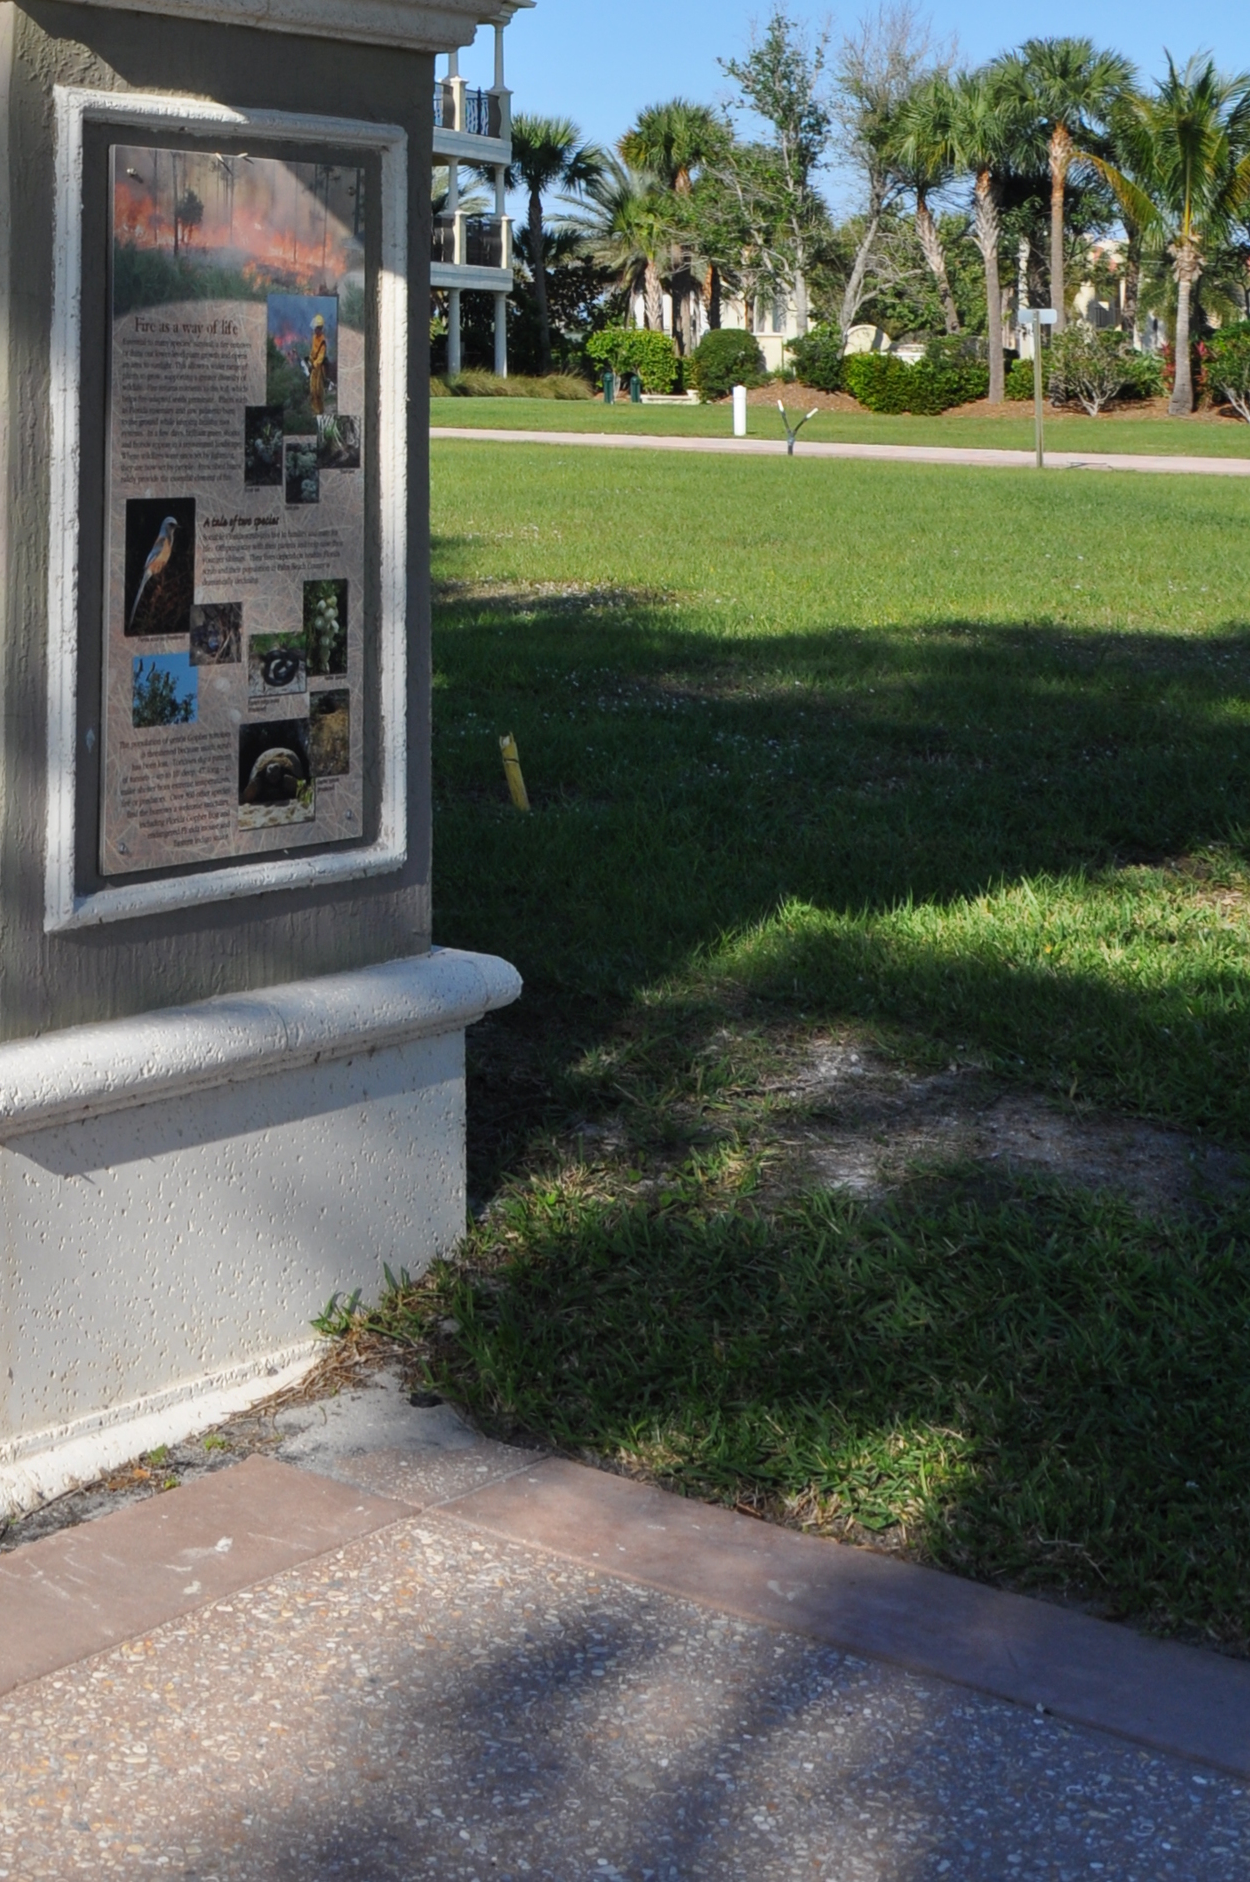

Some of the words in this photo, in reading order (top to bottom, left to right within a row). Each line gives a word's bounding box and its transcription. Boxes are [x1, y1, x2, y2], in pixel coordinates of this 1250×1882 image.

[135, 317, 156, 333] Fire
[159, 323, 170, 333] as
[173, 323, 179, 333] a
[182, 324, 204, 338] way
[207, 319, 217, 335] of
[221, 319, 239, 335] life
[203, 517, 211, 527] A
[211, 515, 228, 527] tale
[229, 514, 238, 532] of
[238, 518, 251, 527] two
[253, 515, 280, 531] species
